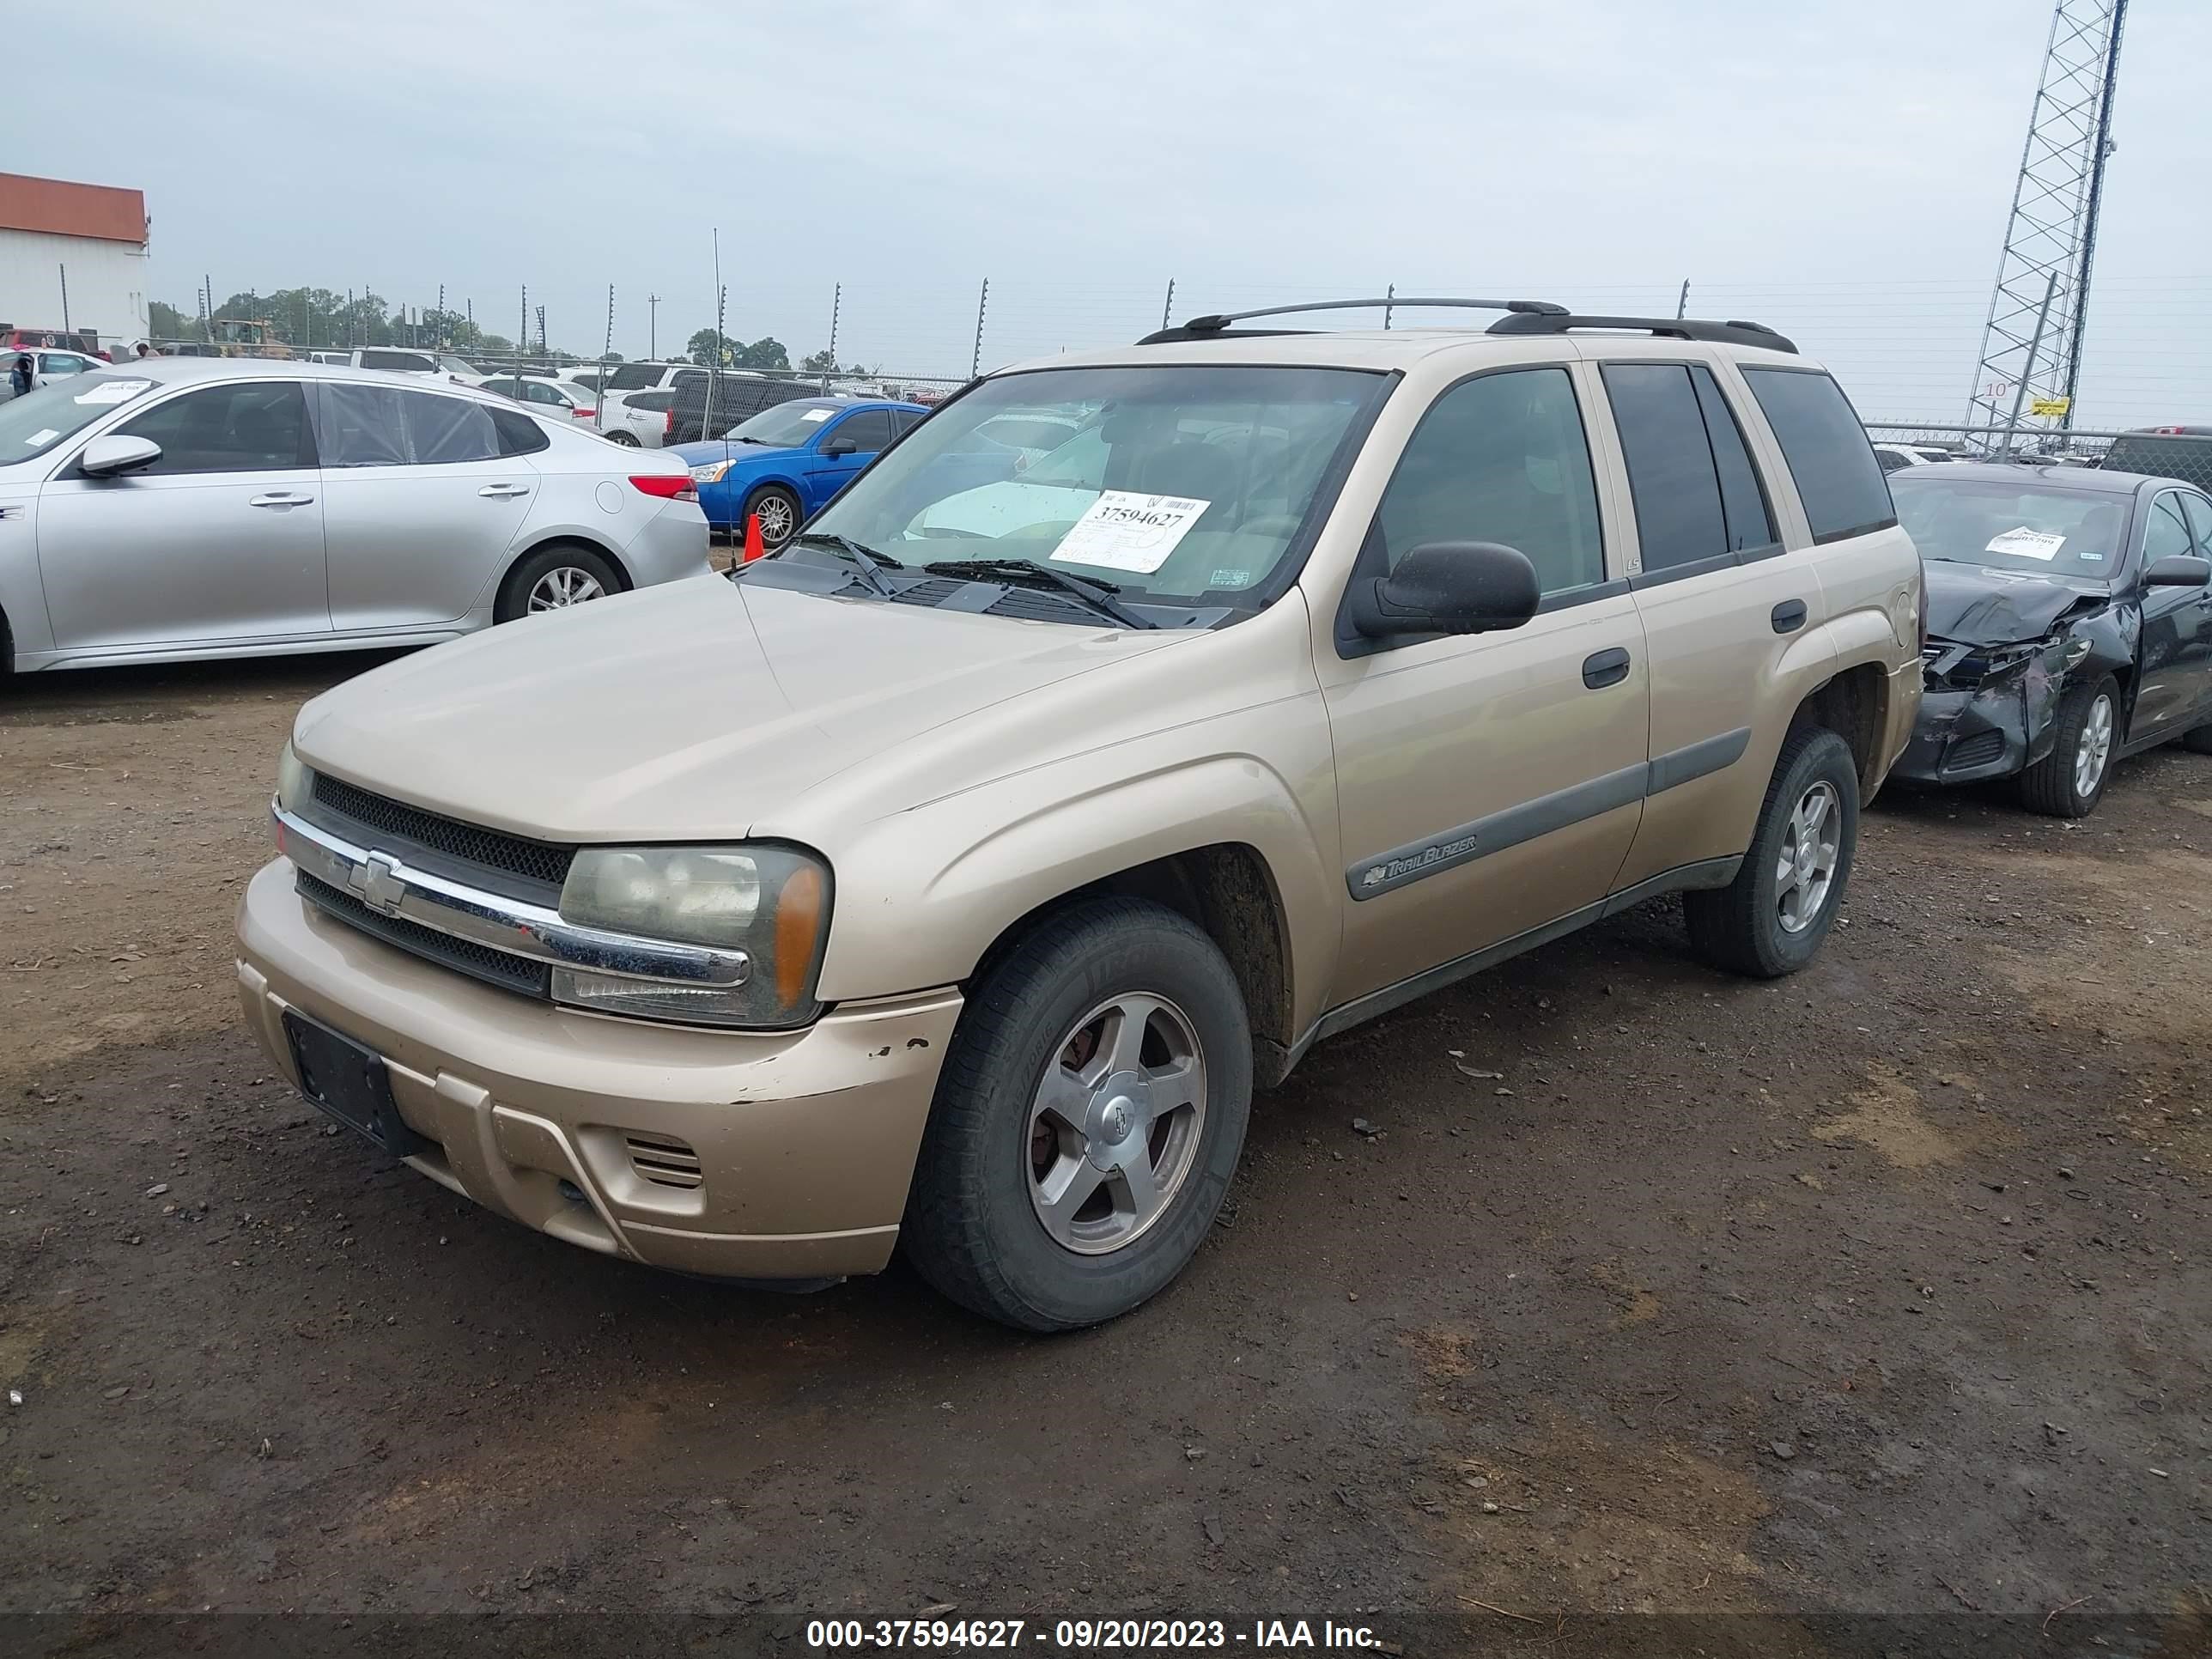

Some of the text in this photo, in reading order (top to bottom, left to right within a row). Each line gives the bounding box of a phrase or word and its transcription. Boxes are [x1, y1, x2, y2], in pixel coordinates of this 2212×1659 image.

[1985, 383, 2006, 397] 10
[1094, 506, 1185, 529] 37594627
[1627, 558, 1639, 570] LS
